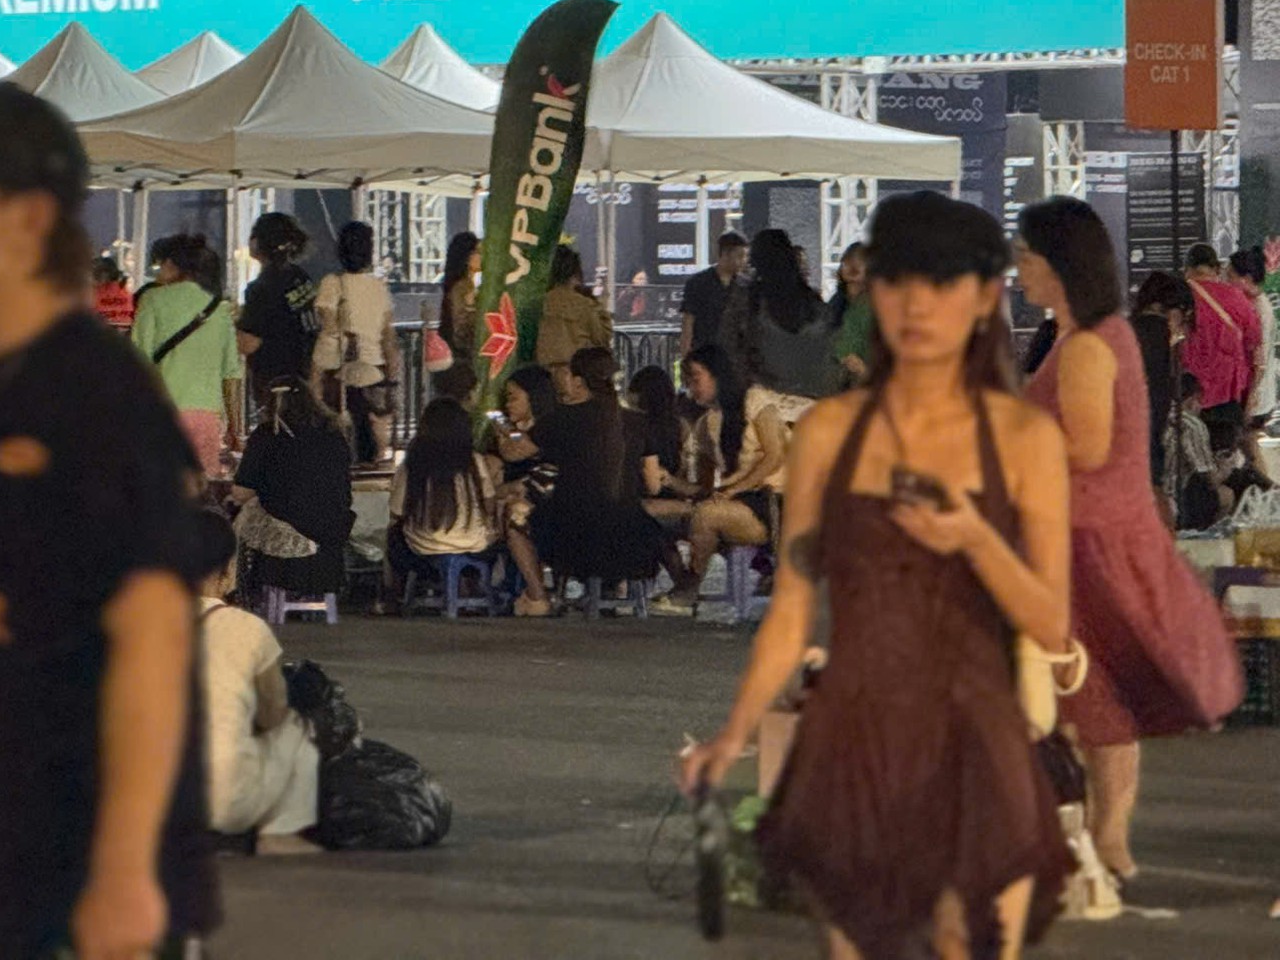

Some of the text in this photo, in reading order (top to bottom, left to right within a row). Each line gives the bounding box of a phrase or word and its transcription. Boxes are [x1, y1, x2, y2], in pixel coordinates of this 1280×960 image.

[1134, 42, 1207, 61] CHECK-IN
[1150, 66, 1190, 83] CAT 1
[505, 73, 582, 286] VPBank
